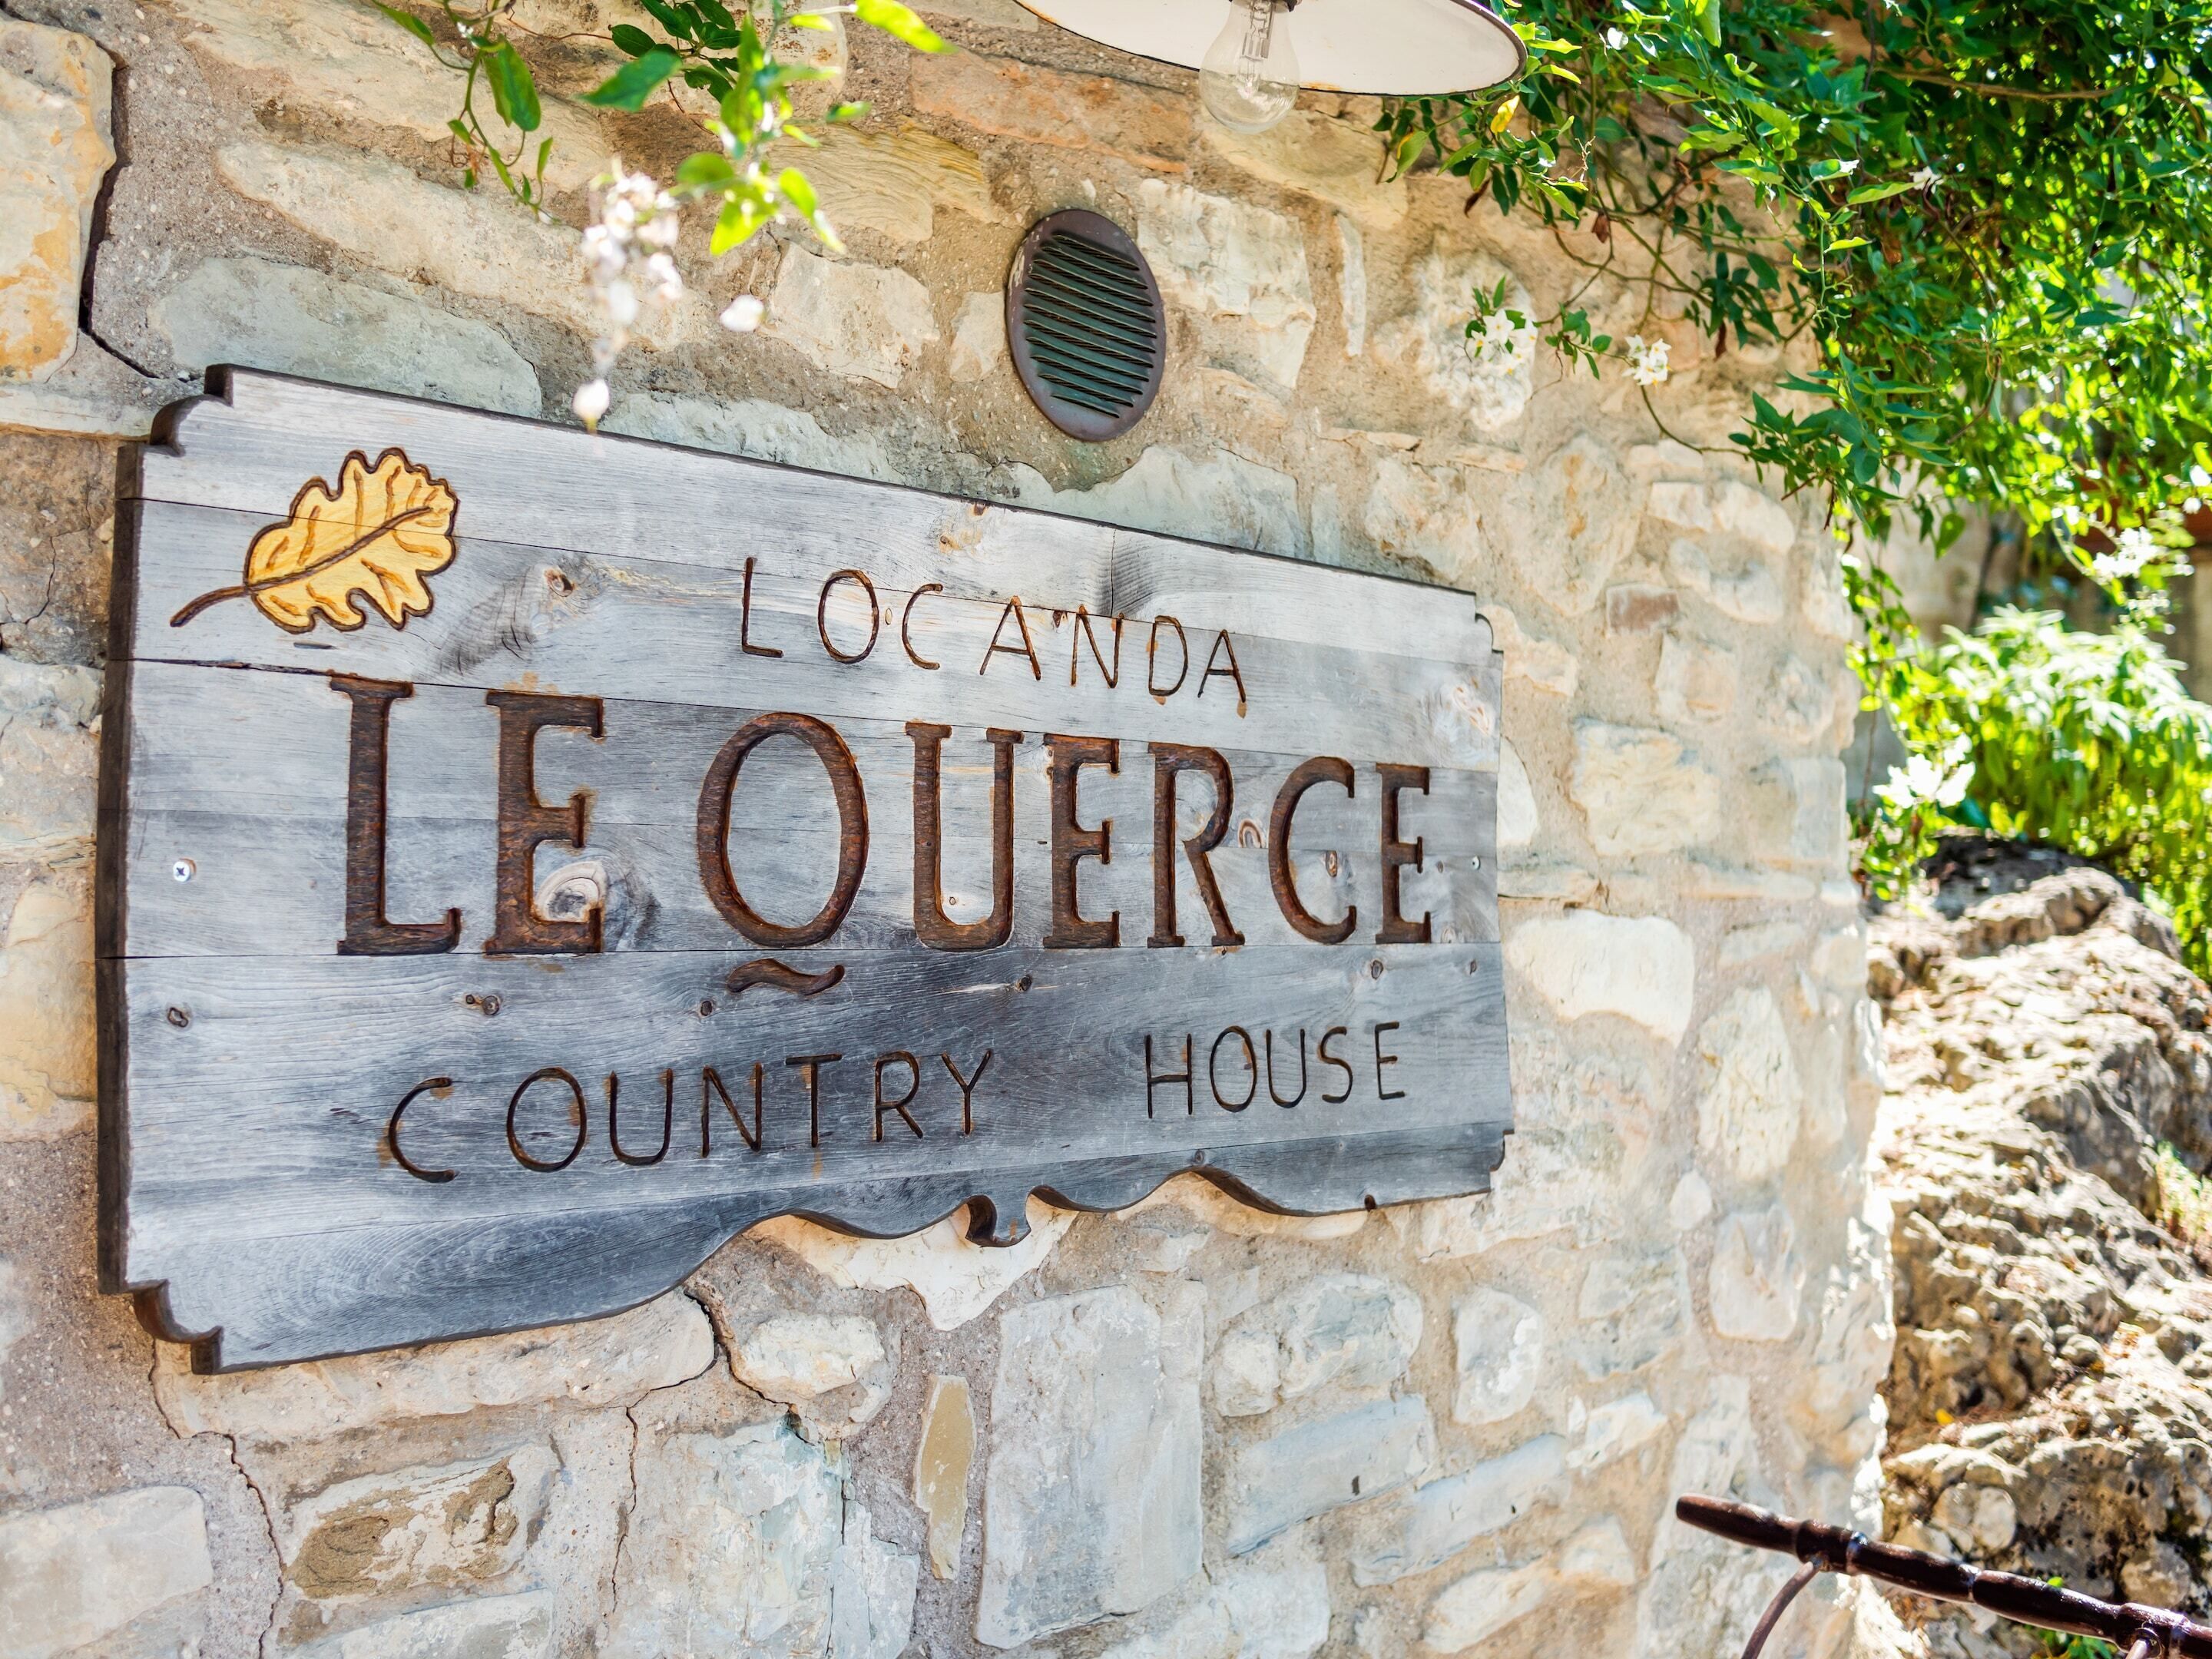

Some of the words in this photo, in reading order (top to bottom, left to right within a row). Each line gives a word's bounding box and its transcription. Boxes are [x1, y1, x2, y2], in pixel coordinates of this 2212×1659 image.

[741, 556, 1247, 703] LOCANDA
[329, 671, 605, 955] LE
[697, 711, 1432, 996] QUERCE
[388, 1048, 994, 1184] COUNTRY
[1144, 1022, 1406, 1119] HOUSE
